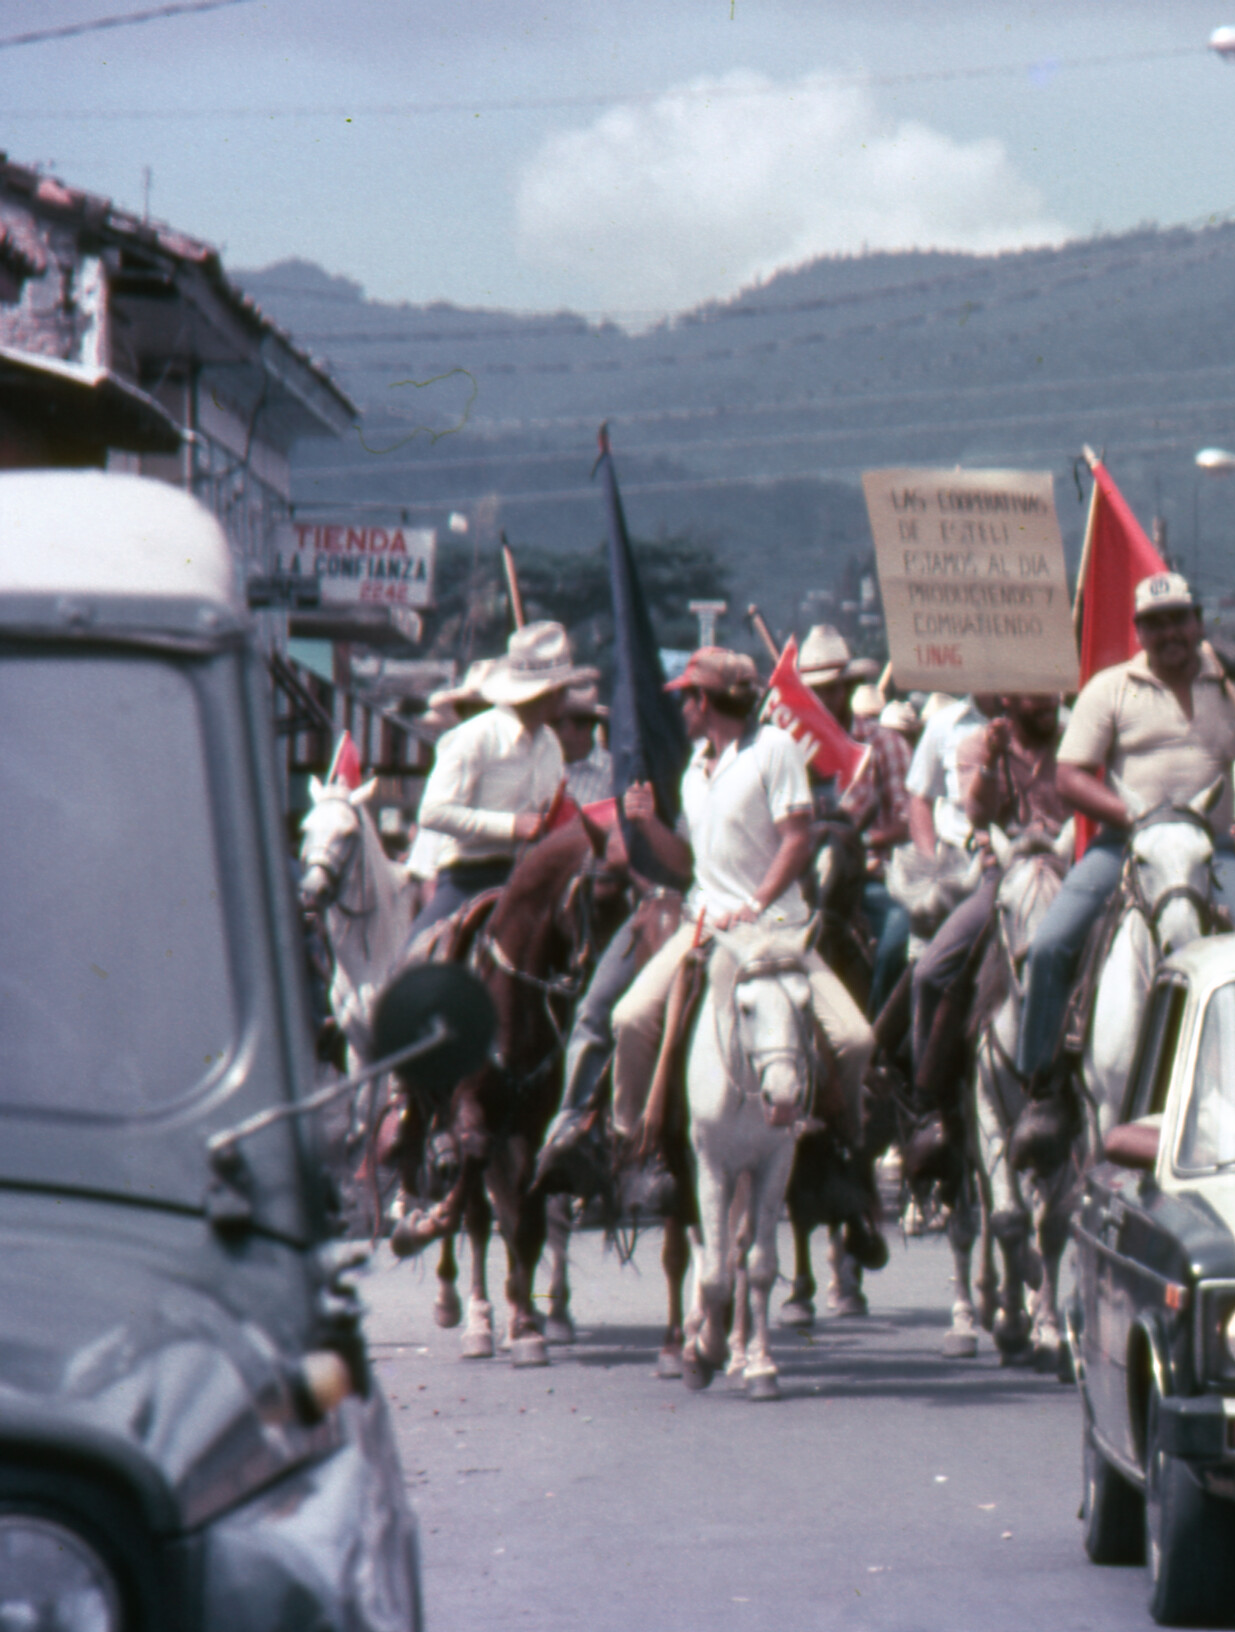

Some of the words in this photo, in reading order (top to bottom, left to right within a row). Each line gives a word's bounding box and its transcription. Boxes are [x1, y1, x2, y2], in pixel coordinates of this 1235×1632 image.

[293, 523, 407, 553] TIENDA
[898, 517, 918, 541] DE
[273, 552, 301, 573] LA
[314, 553, 427, 581] CONFIANZA
[988, 552, 1010, 576] AL
[1018, 552, 1050, 576] DIA
